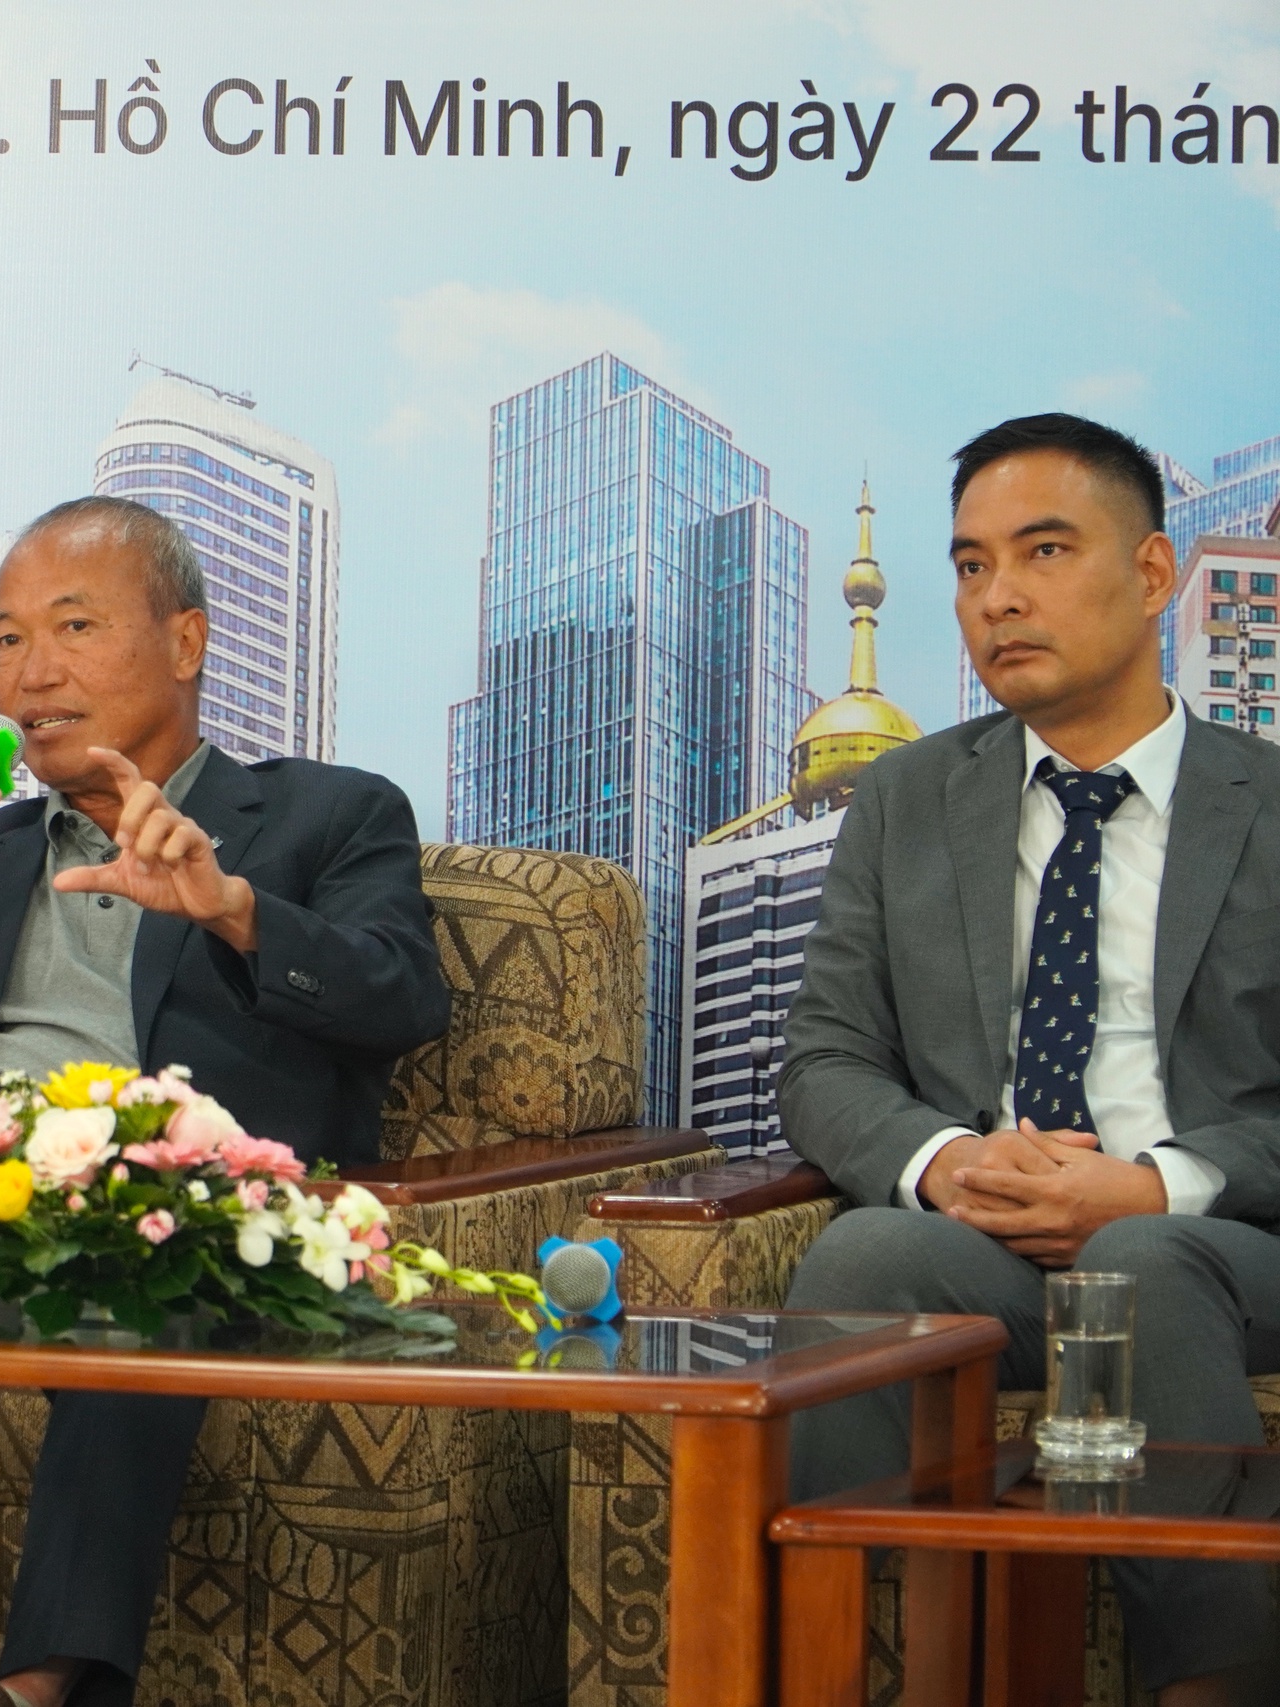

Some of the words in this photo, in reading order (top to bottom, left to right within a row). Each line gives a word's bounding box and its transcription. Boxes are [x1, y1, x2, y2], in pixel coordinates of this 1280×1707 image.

[49, 59, 168, 155] Hồ
[202, 77, 353, 156] Chí
[384, 78, 632, 177] Minh,
[670, 80, 896, 182] ngày
[930, 83, 1041, 162] 22
[1074, 82, 1280, 165] thán
